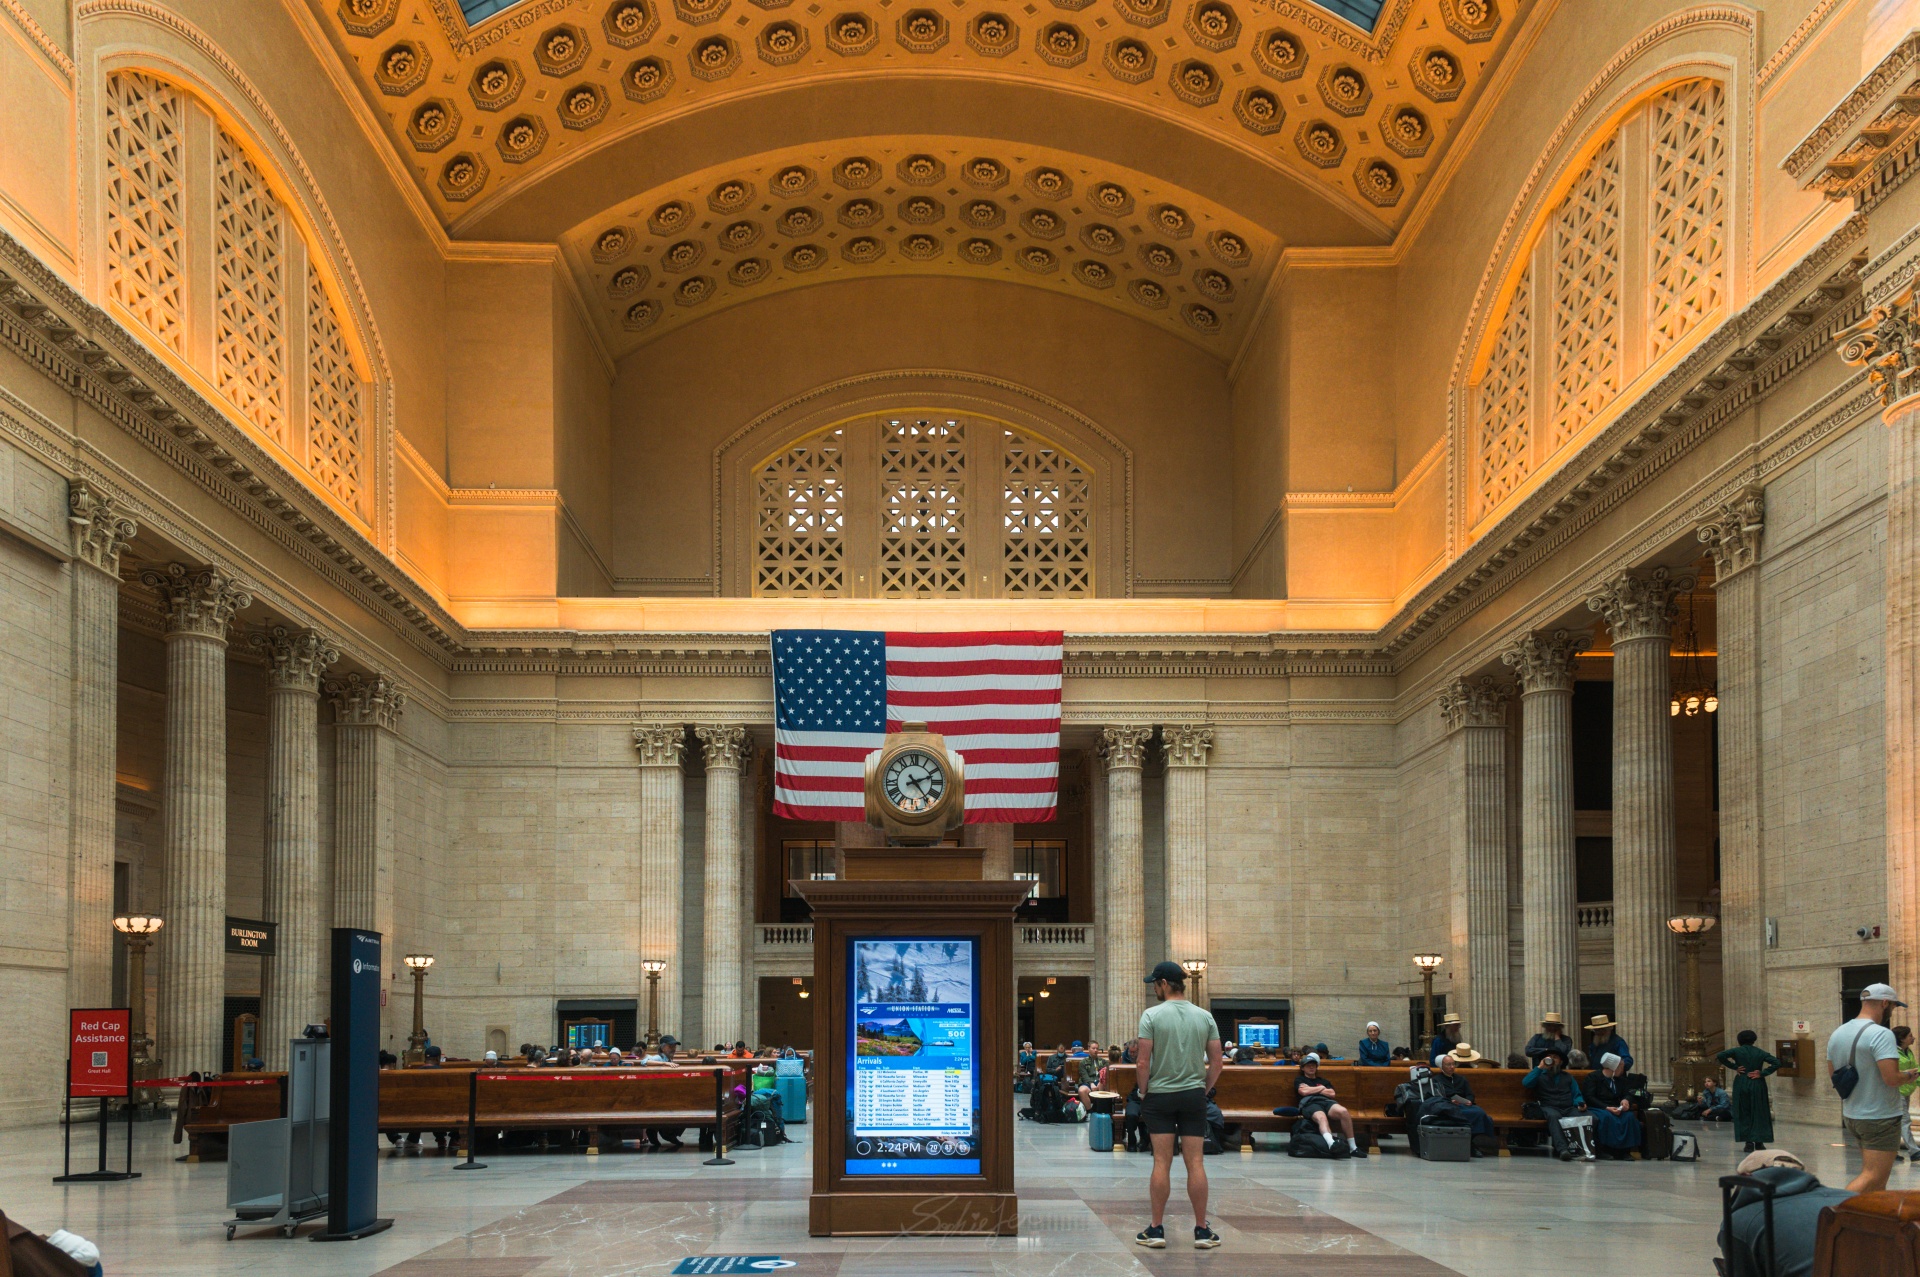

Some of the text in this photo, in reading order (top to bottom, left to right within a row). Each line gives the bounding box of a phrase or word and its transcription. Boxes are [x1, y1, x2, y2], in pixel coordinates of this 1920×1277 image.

[231, 928, 267, 940] BURLINGTON
[241, 938, 258, 948] ROOM
[81, 1021, 120, 1032] Red Cap
[75, 1034, 125, 1043] Assistance
[857, 1057, 882, 1065] Arrivals
[877, 1142, 921, 1153] 2:24PM
